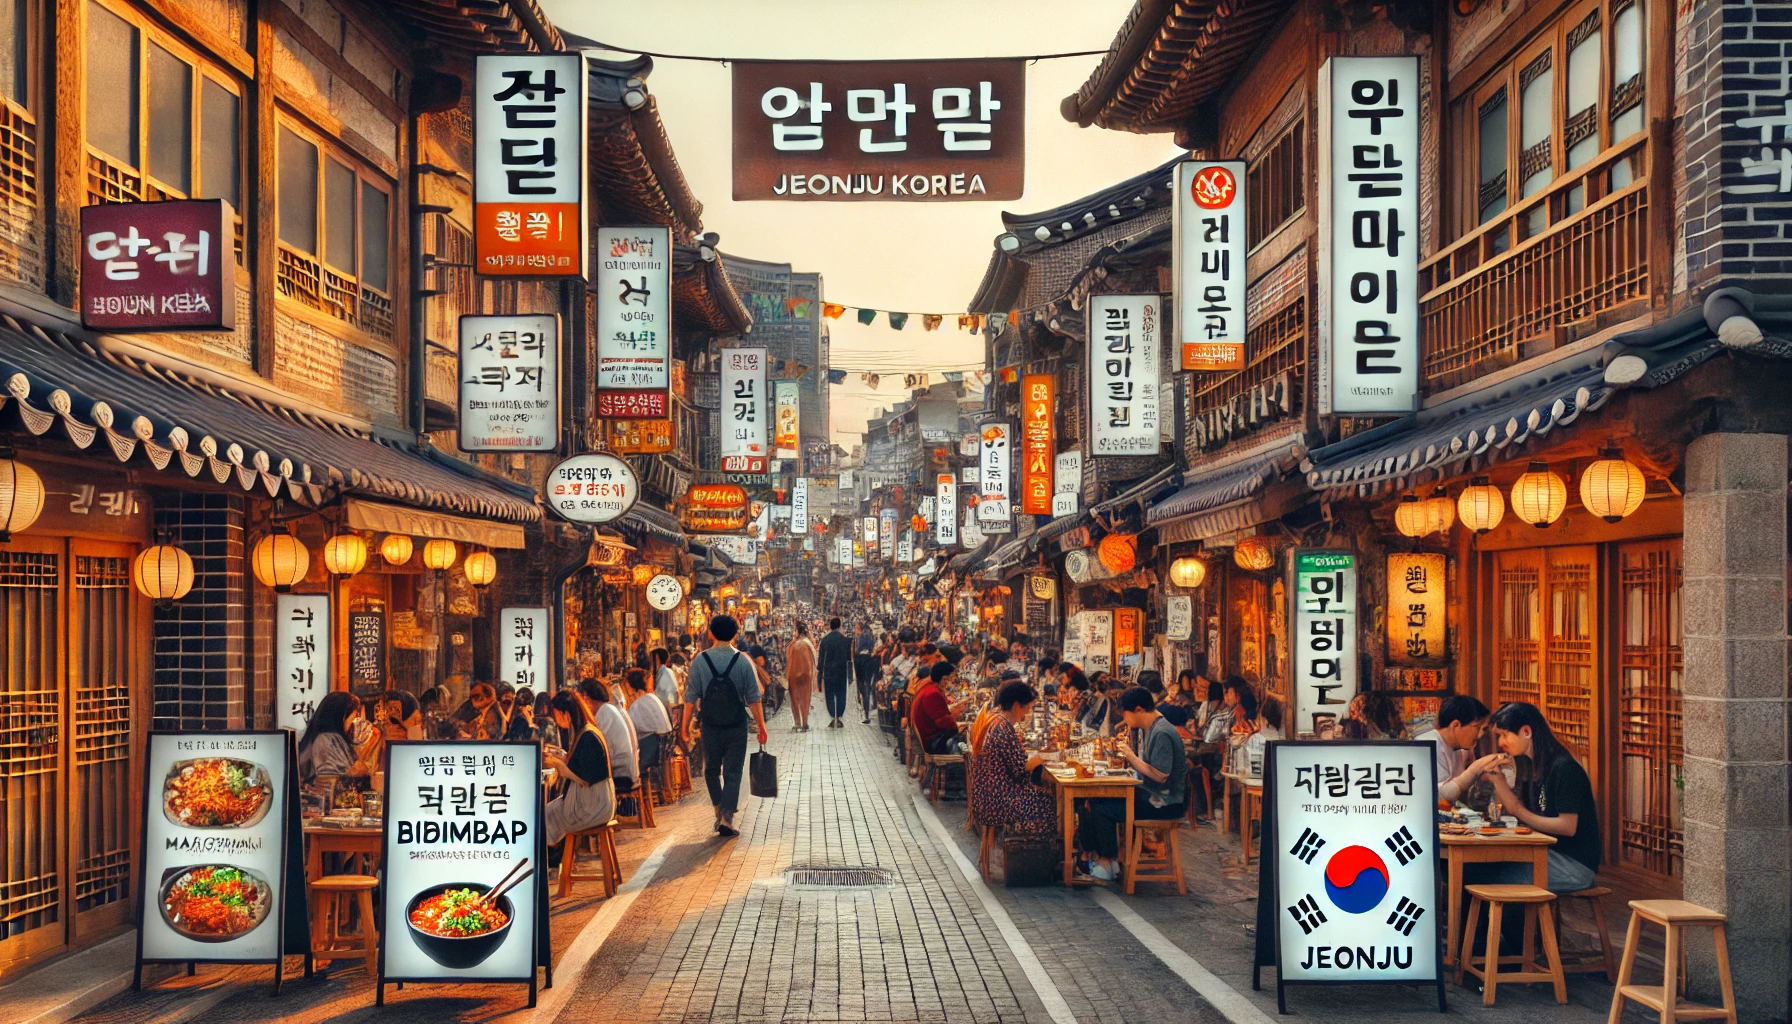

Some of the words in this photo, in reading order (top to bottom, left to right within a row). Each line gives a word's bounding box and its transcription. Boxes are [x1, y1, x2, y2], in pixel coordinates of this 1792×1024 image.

[773, 173, 883, 195] JEONJU
[892, 172, 987, 196] KOREA
[1300, 946, 1413, 970] JEONJU
